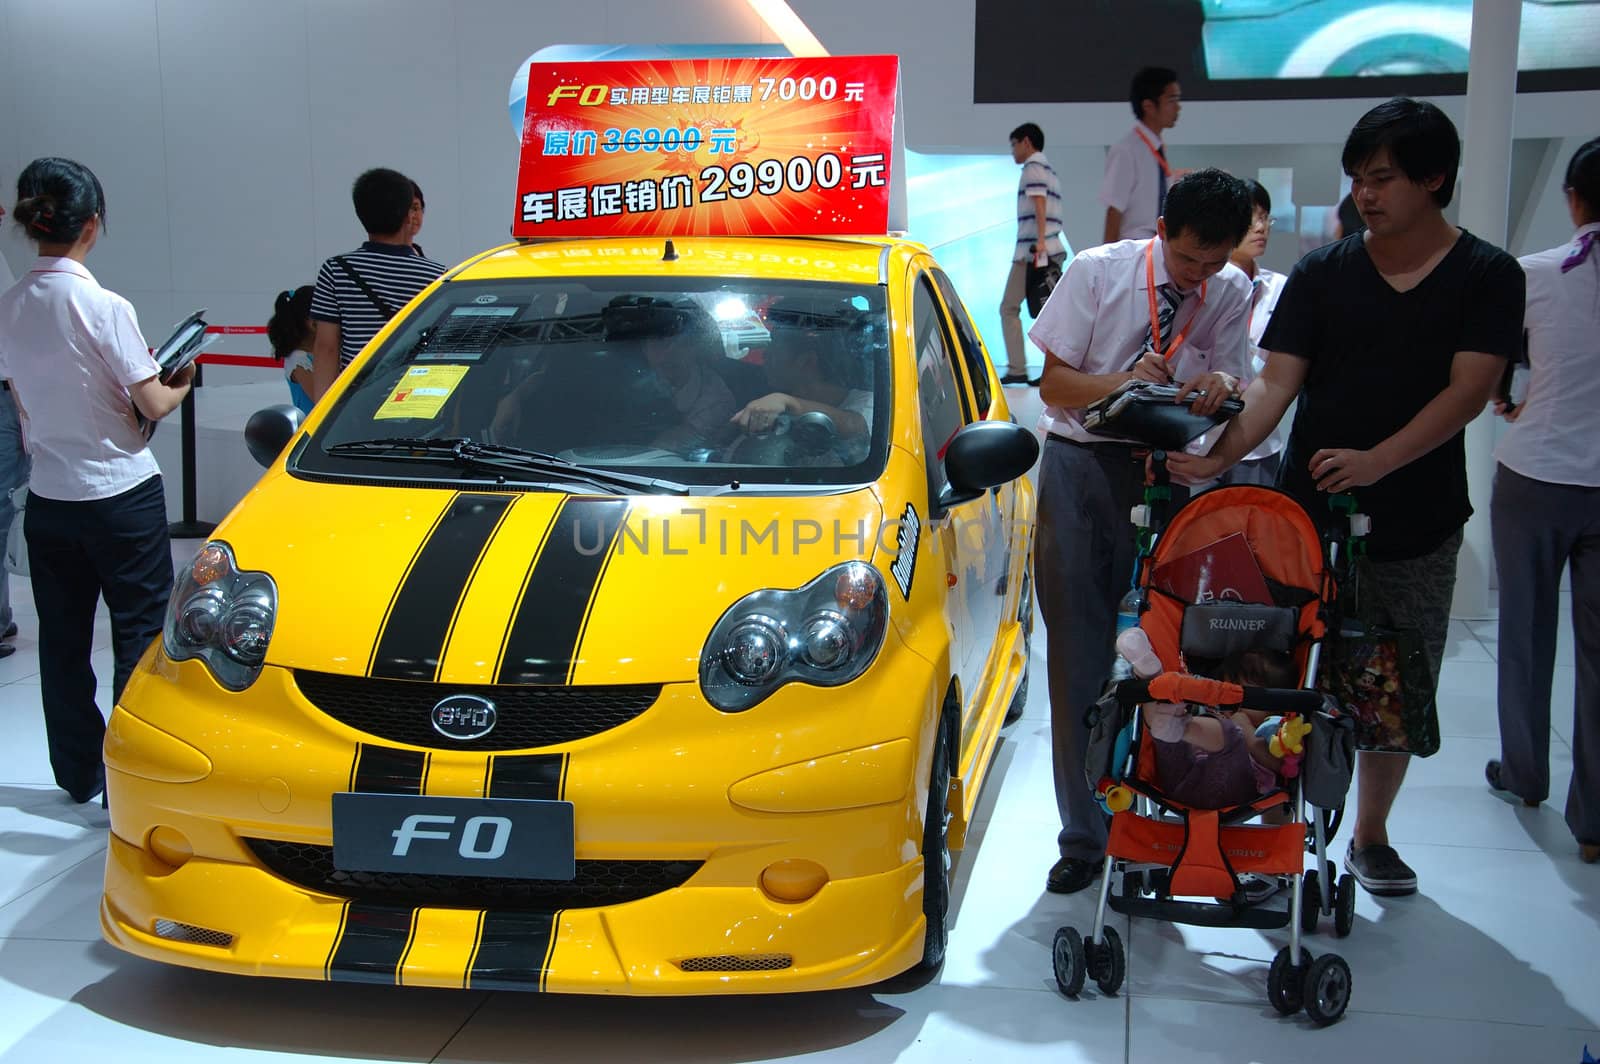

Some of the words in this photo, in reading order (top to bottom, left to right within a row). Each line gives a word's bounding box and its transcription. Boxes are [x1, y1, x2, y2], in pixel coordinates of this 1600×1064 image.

[759, 77, 837, 101] 7000
[844, 82, 865, 102] 元
[543, 131, 597, 155] 原价
[602, 128, 704, 153] 36900
[709, 128, 737, 154] 元
[521, 176, 693, 224] 车展促销价
[699, 153, 842, 202] 29900
[850, 153, 886, 189] 元
[1209, 618, 1266, 631] RUNNER
[439, 707, 487, 727] BYD
